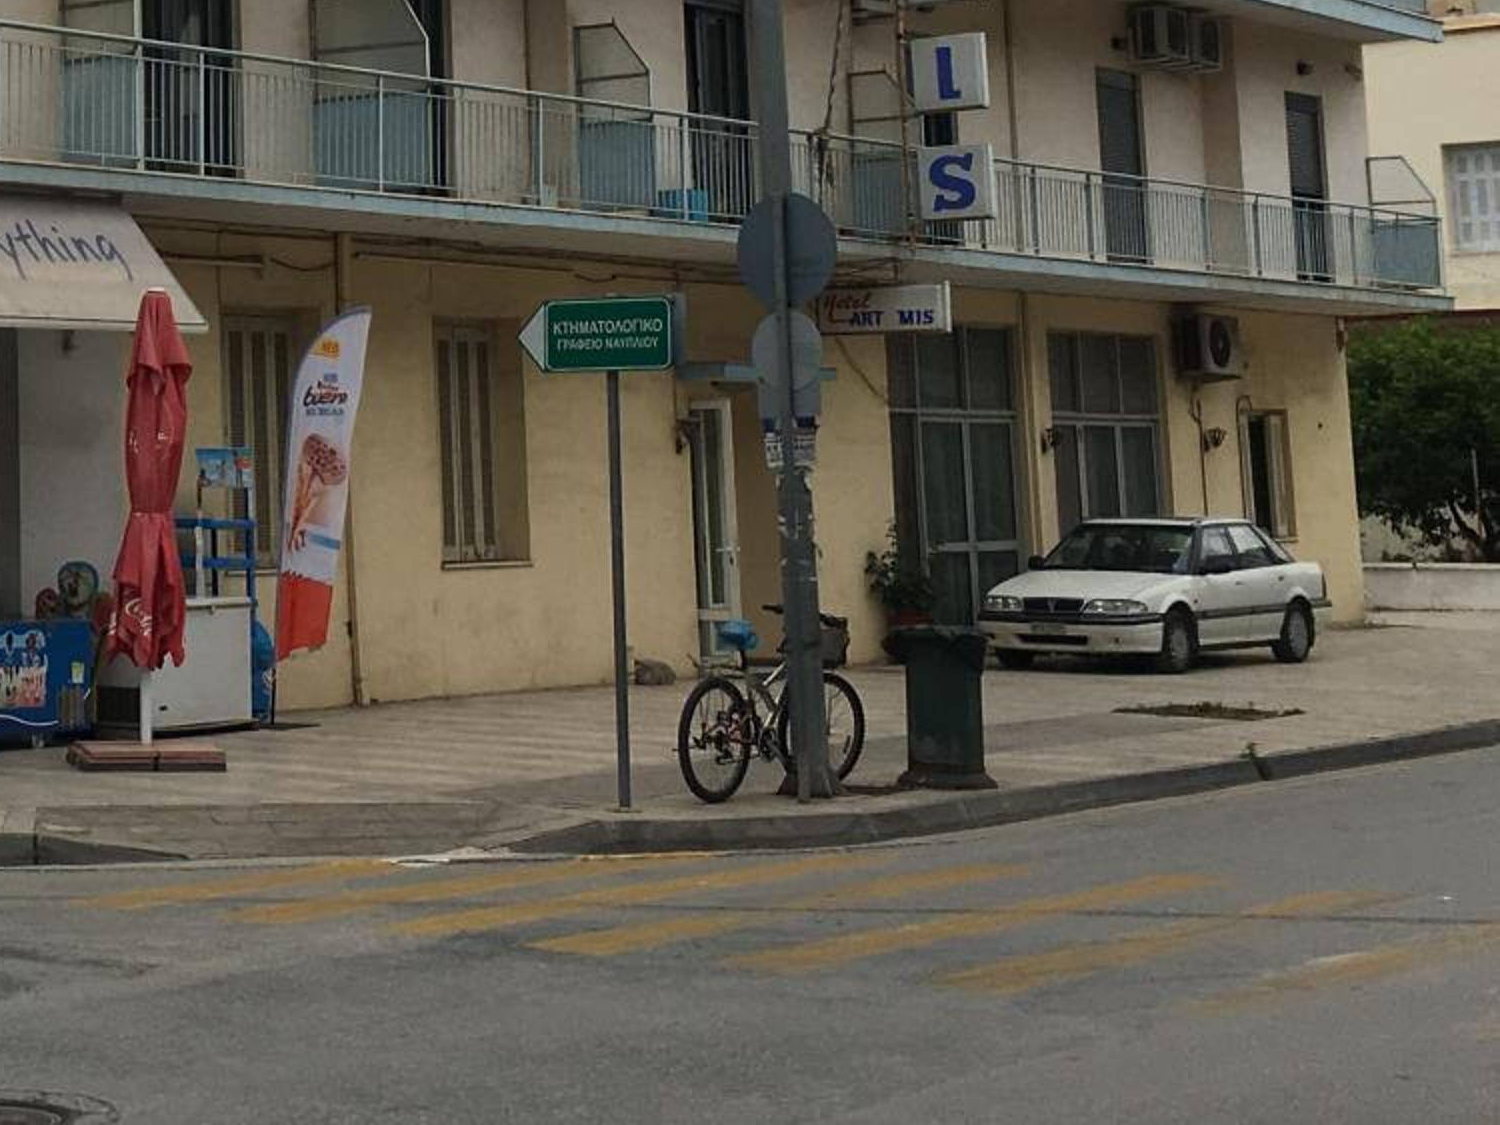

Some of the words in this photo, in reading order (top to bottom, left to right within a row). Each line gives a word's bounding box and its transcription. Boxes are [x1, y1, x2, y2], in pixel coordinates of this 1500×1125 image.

[552, 318, 664, 335] ΚΤΗΜΑΤΟΛΟΓΙΚΟ
[556, 337, 603, 351] ΓΡΑΦΕΙΟ
[605, 335, 660, 349] ΝΑΥΠΛΙΟΥ
